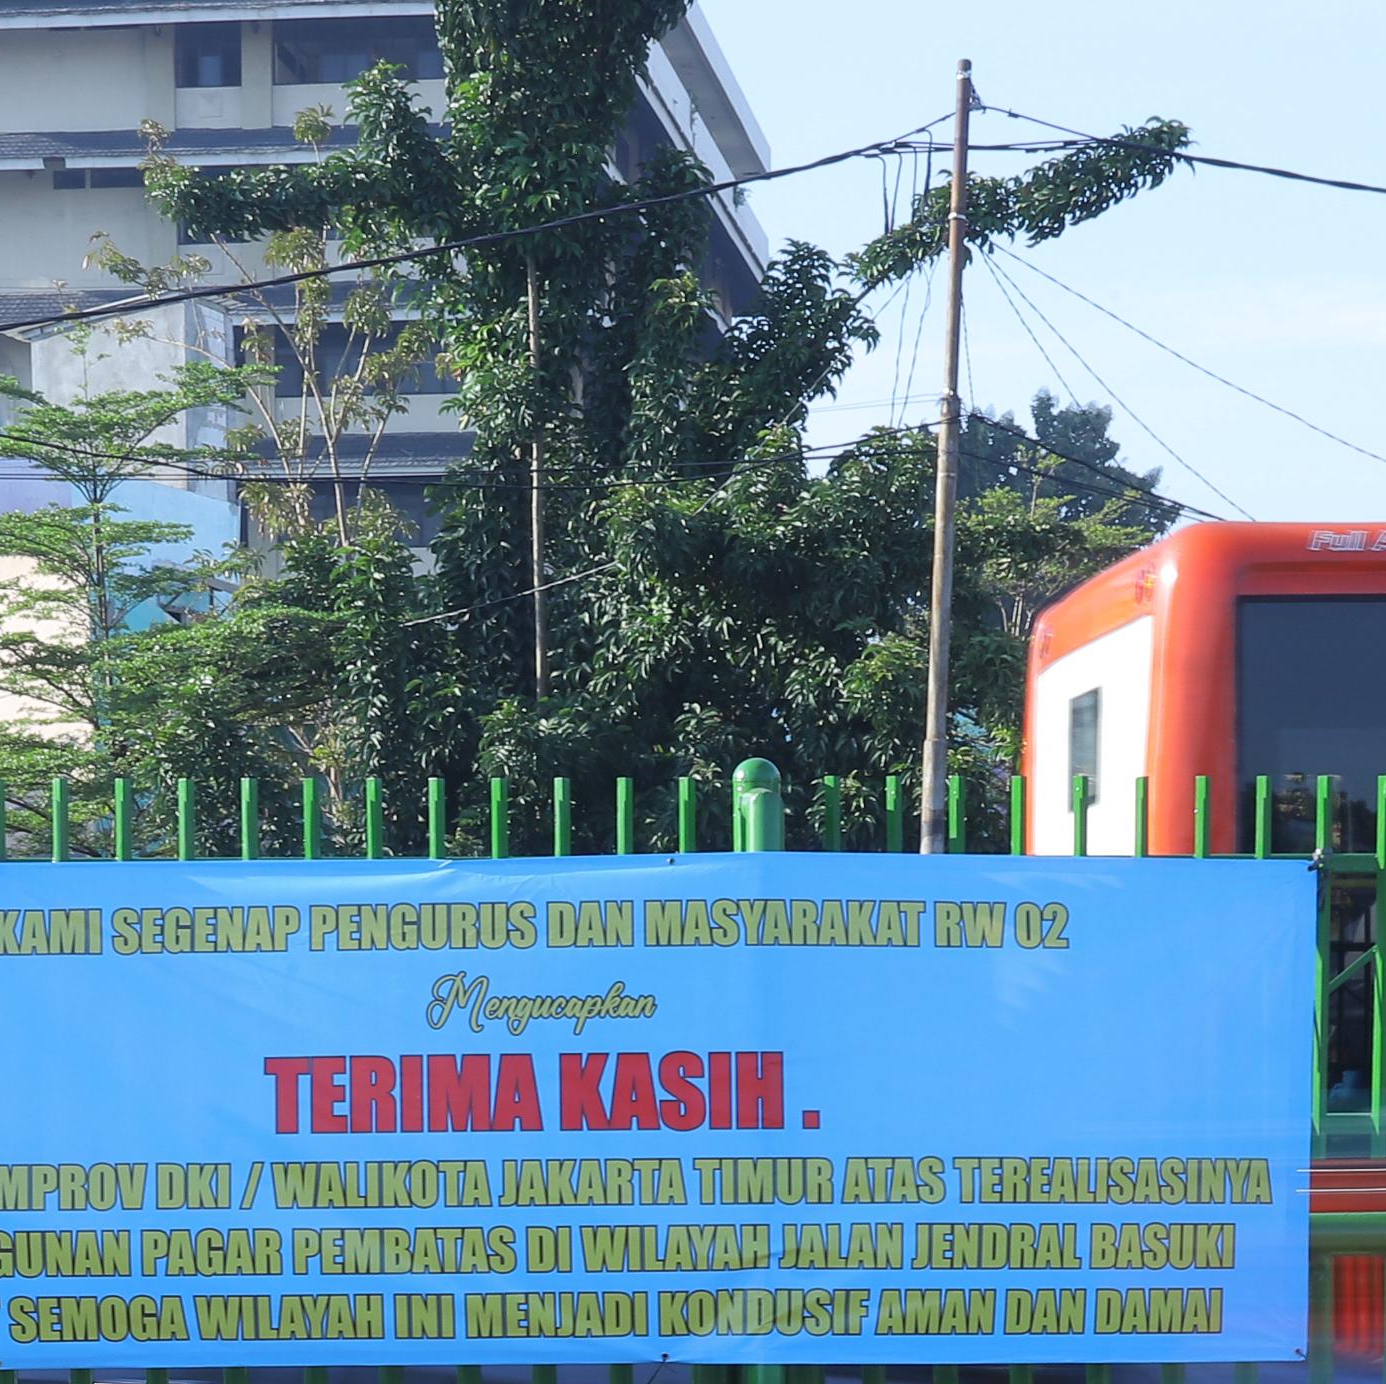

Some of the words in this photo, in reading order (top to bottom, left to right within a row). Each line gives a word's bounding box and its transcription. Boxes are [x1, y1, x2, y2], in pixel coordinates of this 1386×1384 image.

[1307, 530, 1366, 551] Full
[112, 906, 300, 955] SEGENAP
[310, 901, 537, 951] PENGURUS
[547, 900, 634, 948] DAN
[645, 898, 926, 947] MASYARAKAT
[935, 901, 1006, 948] RW
[1015, 902, 1069, 949] 02
[427, 971, 657, 1036] Mengucapkan
[264, 1053, 543, 1134] TERIMA
[156, 1163, 231, 1210] DKI
[240, 1162, 264, 1210] /
[271, 1160, 493, 1209] WALIKOTA
[499, 1158, 687, 1207] JAKARTA
[693, 1157, 833, 1205] TIMUR
[841, 1156, 945, 1204] ATAS
[953, 1157, 1272, 1205] TEREALISASINYA
[141, 1228, 283, 1277] PAGAR
[293, 1228, 517, 1275] PEMBATAS
[526, 1226, 572, 1273] DI
[580, 1224, 771, 1273] WILAYAH
[779, 1223, 903, 1270] JALAN
[911, 1223, 1082, 1270] JENDRAL
[1089, 1222, 1235, 1270] BASUKI
[8, 1295, 190, 1344] SEMOGA
[193, 1293, 385, 1341] WILAYAH
[394, 1293, 455, 1340] INI
[465, 1291, 648, 1340] MENJADI
[658, 1288, 870, 1337] KONDUSIF
[875, 1289, 996, 1335] AMAN
[1004, 1288, 1086, 1335] DAN
[1094, 1288, 1223, 1334] DAMAI
